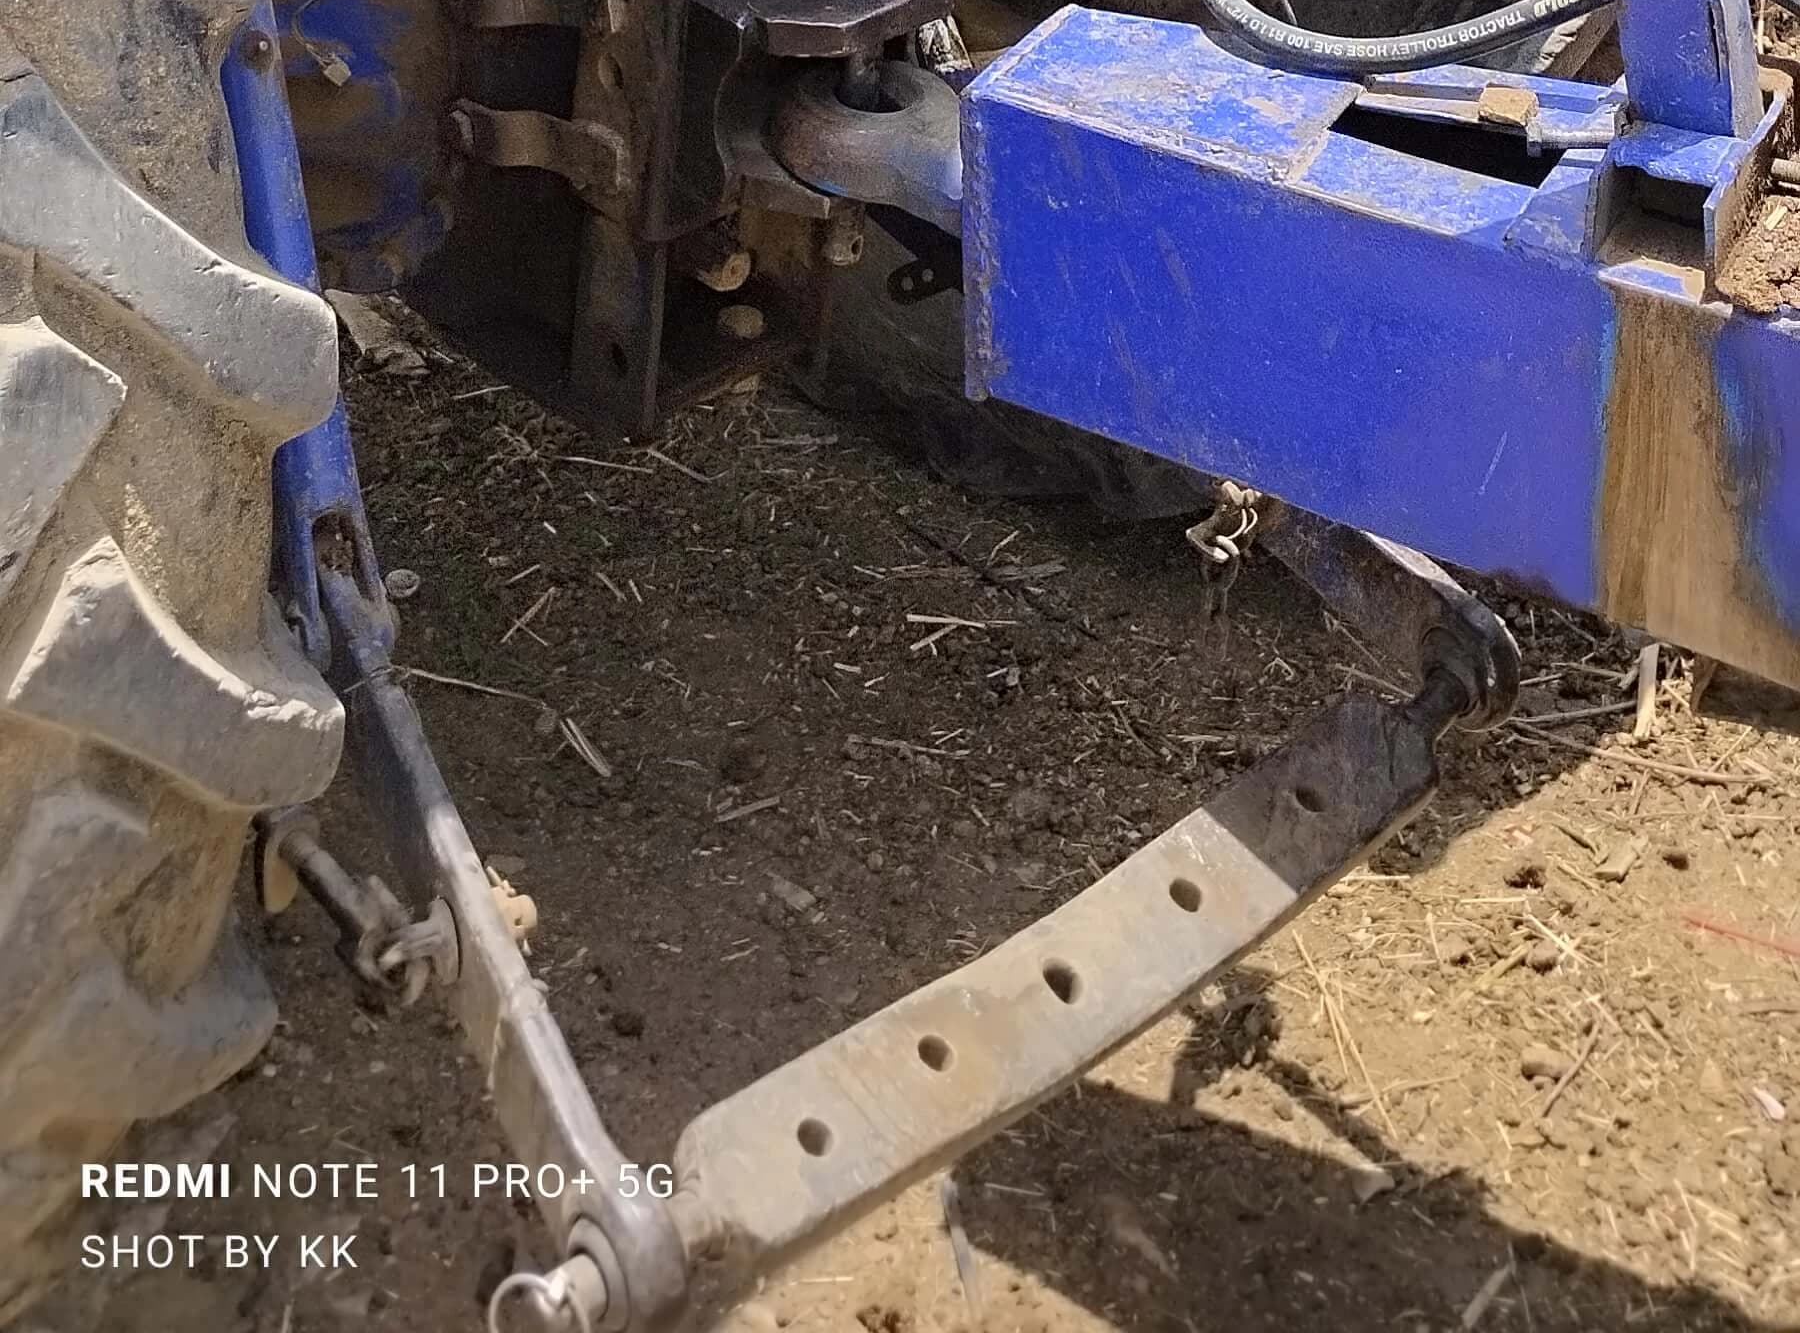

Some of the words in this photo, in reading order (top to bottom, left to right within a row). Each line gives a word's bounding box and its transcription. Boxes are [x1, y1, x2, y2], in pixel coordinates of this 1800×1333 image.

[1457, 10, 1526, 43] TRACTOR
[1287, 35, 1311, 51] 100
[1311, 42, 1343, 58] SAE
[1346, 44, 1387, 58] HOSE
[1390, 31, 1458, 56] TROLLEY
